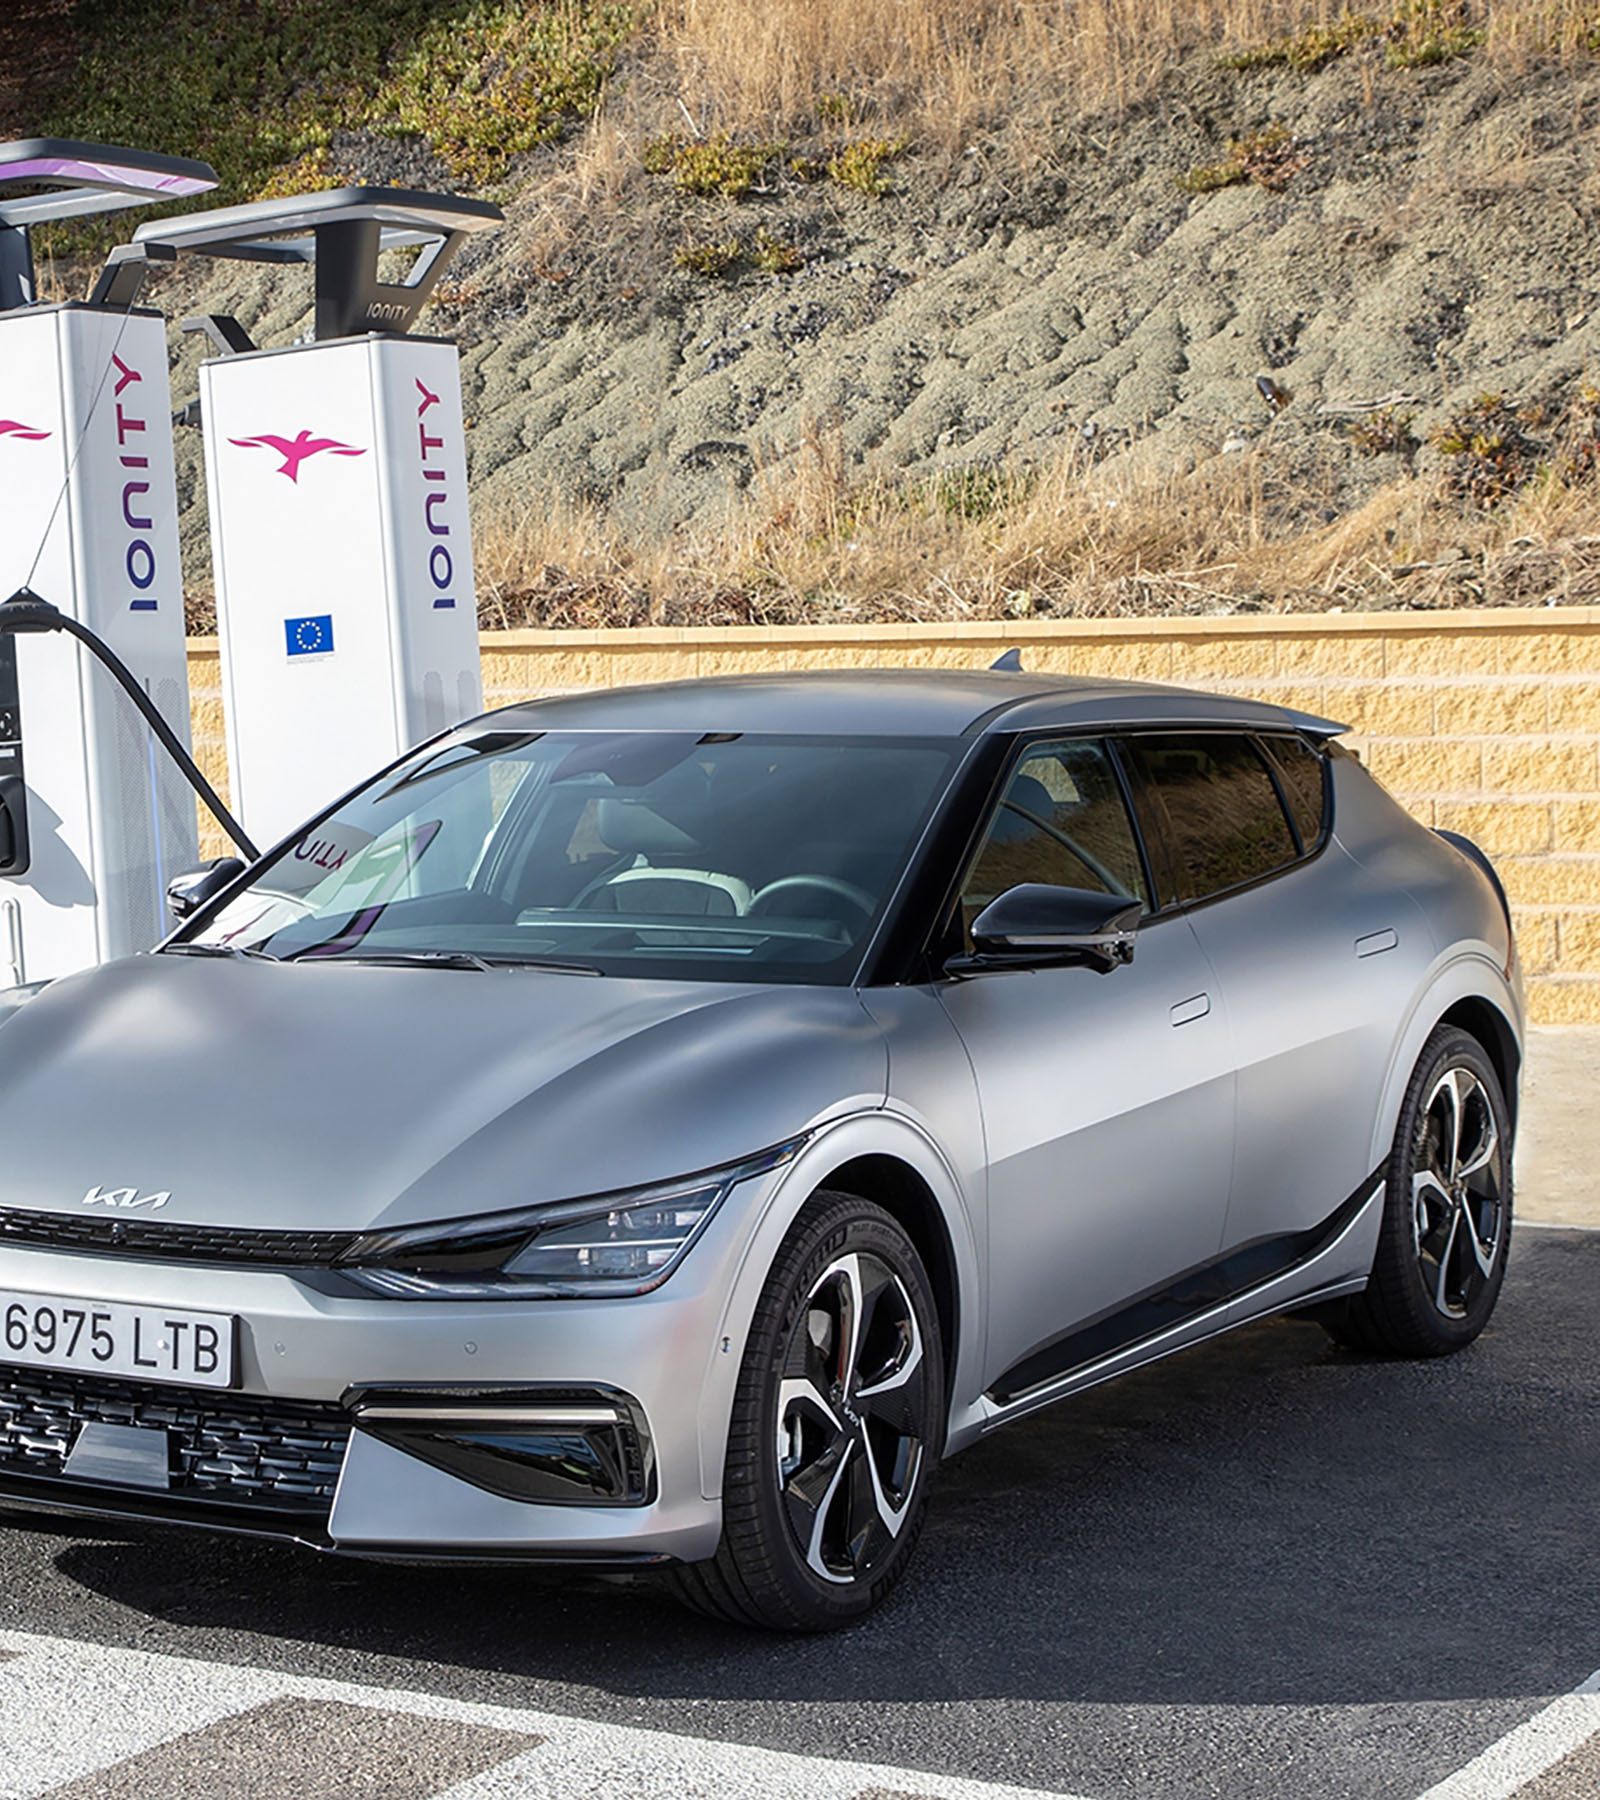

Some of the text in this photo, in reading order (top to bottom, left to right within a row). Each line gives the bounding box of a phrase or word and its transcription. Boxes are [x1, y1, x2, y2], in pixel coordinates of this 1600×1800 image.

[366, 302, 412, 321] IONITY
[111, 350, 159, 612] IONITY
[414, 376, 457, 610] IONITY
[82, 1183, 172, 1212] KIA
[4, 1303, 219, 1374] 6975 LTB
